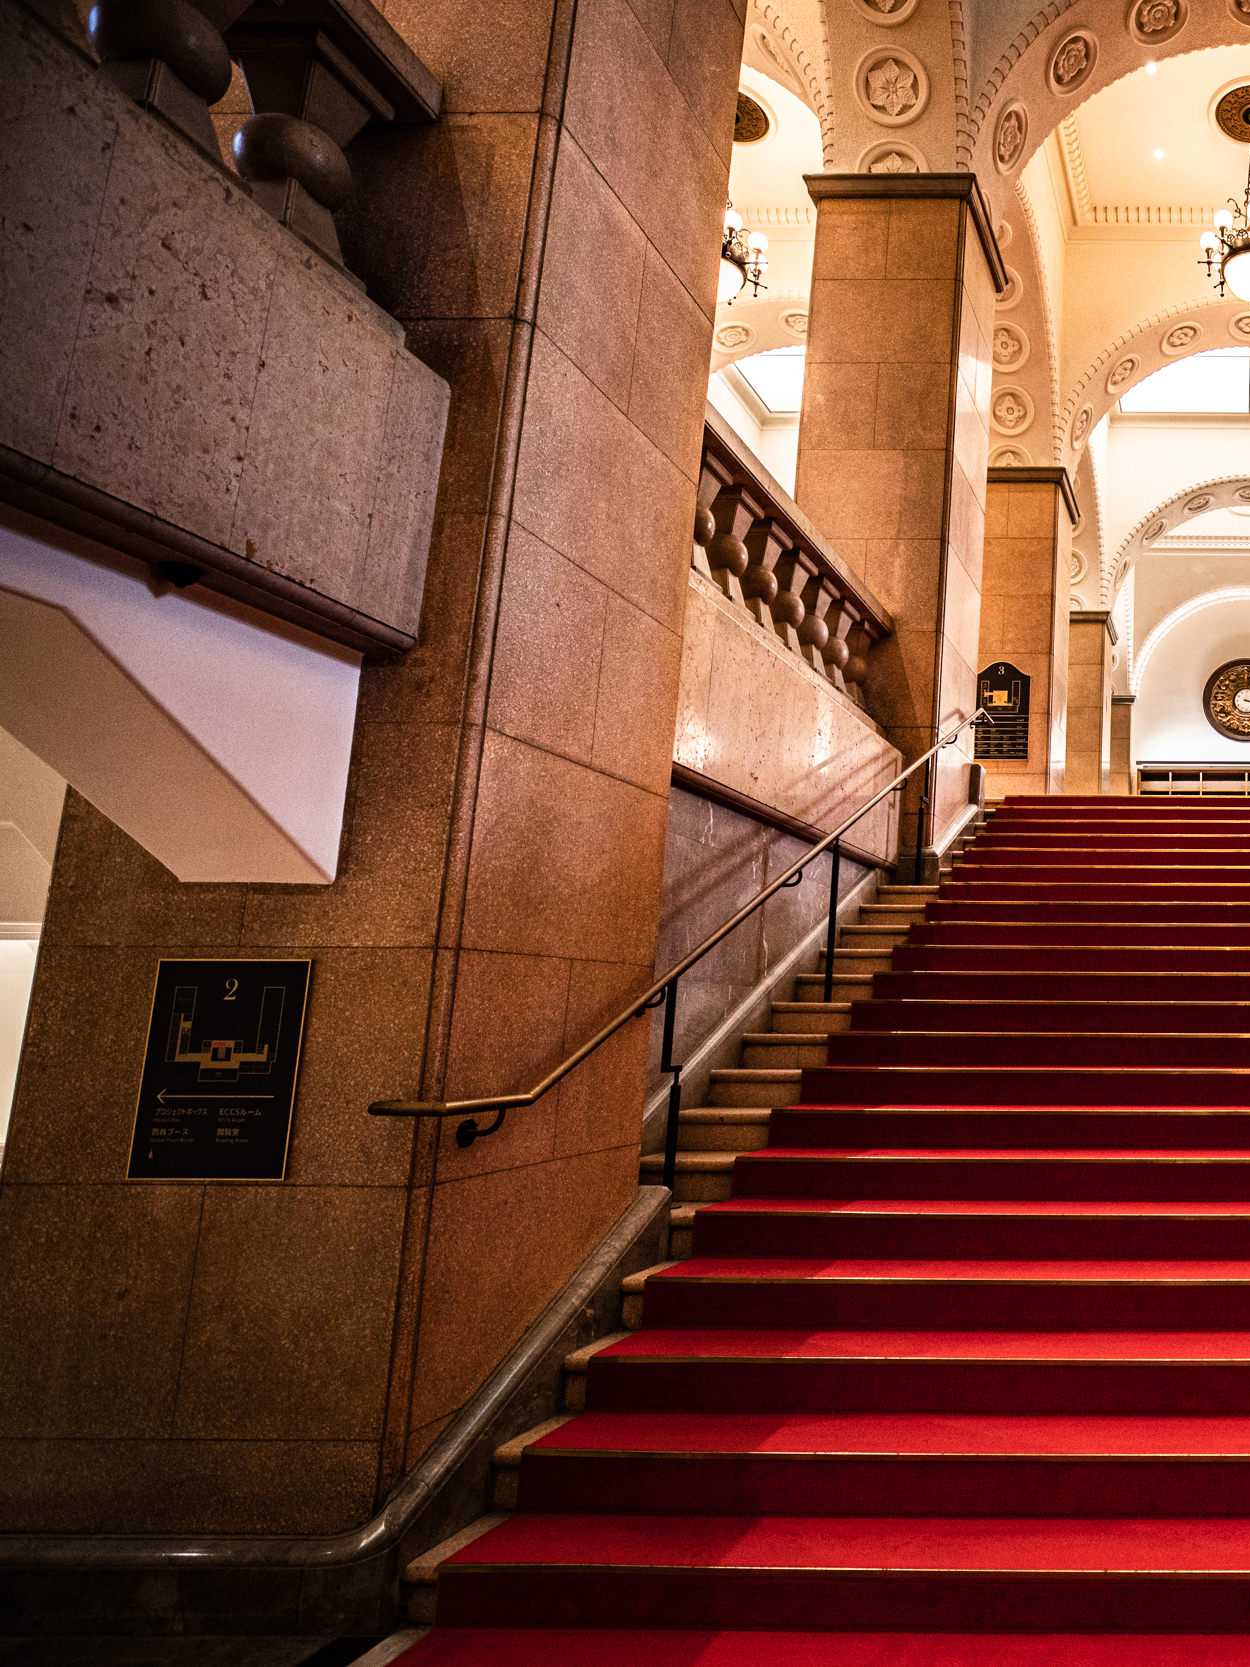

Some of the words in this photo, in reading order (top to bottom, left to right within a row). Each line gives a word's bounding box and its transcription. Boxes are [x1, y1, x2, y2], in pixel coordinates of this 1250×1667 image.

[998, 665, 1005, 675] 3
[222, 978, 239, 1001] 2
[219, 1107, 262, 1116] ECCSルーム
